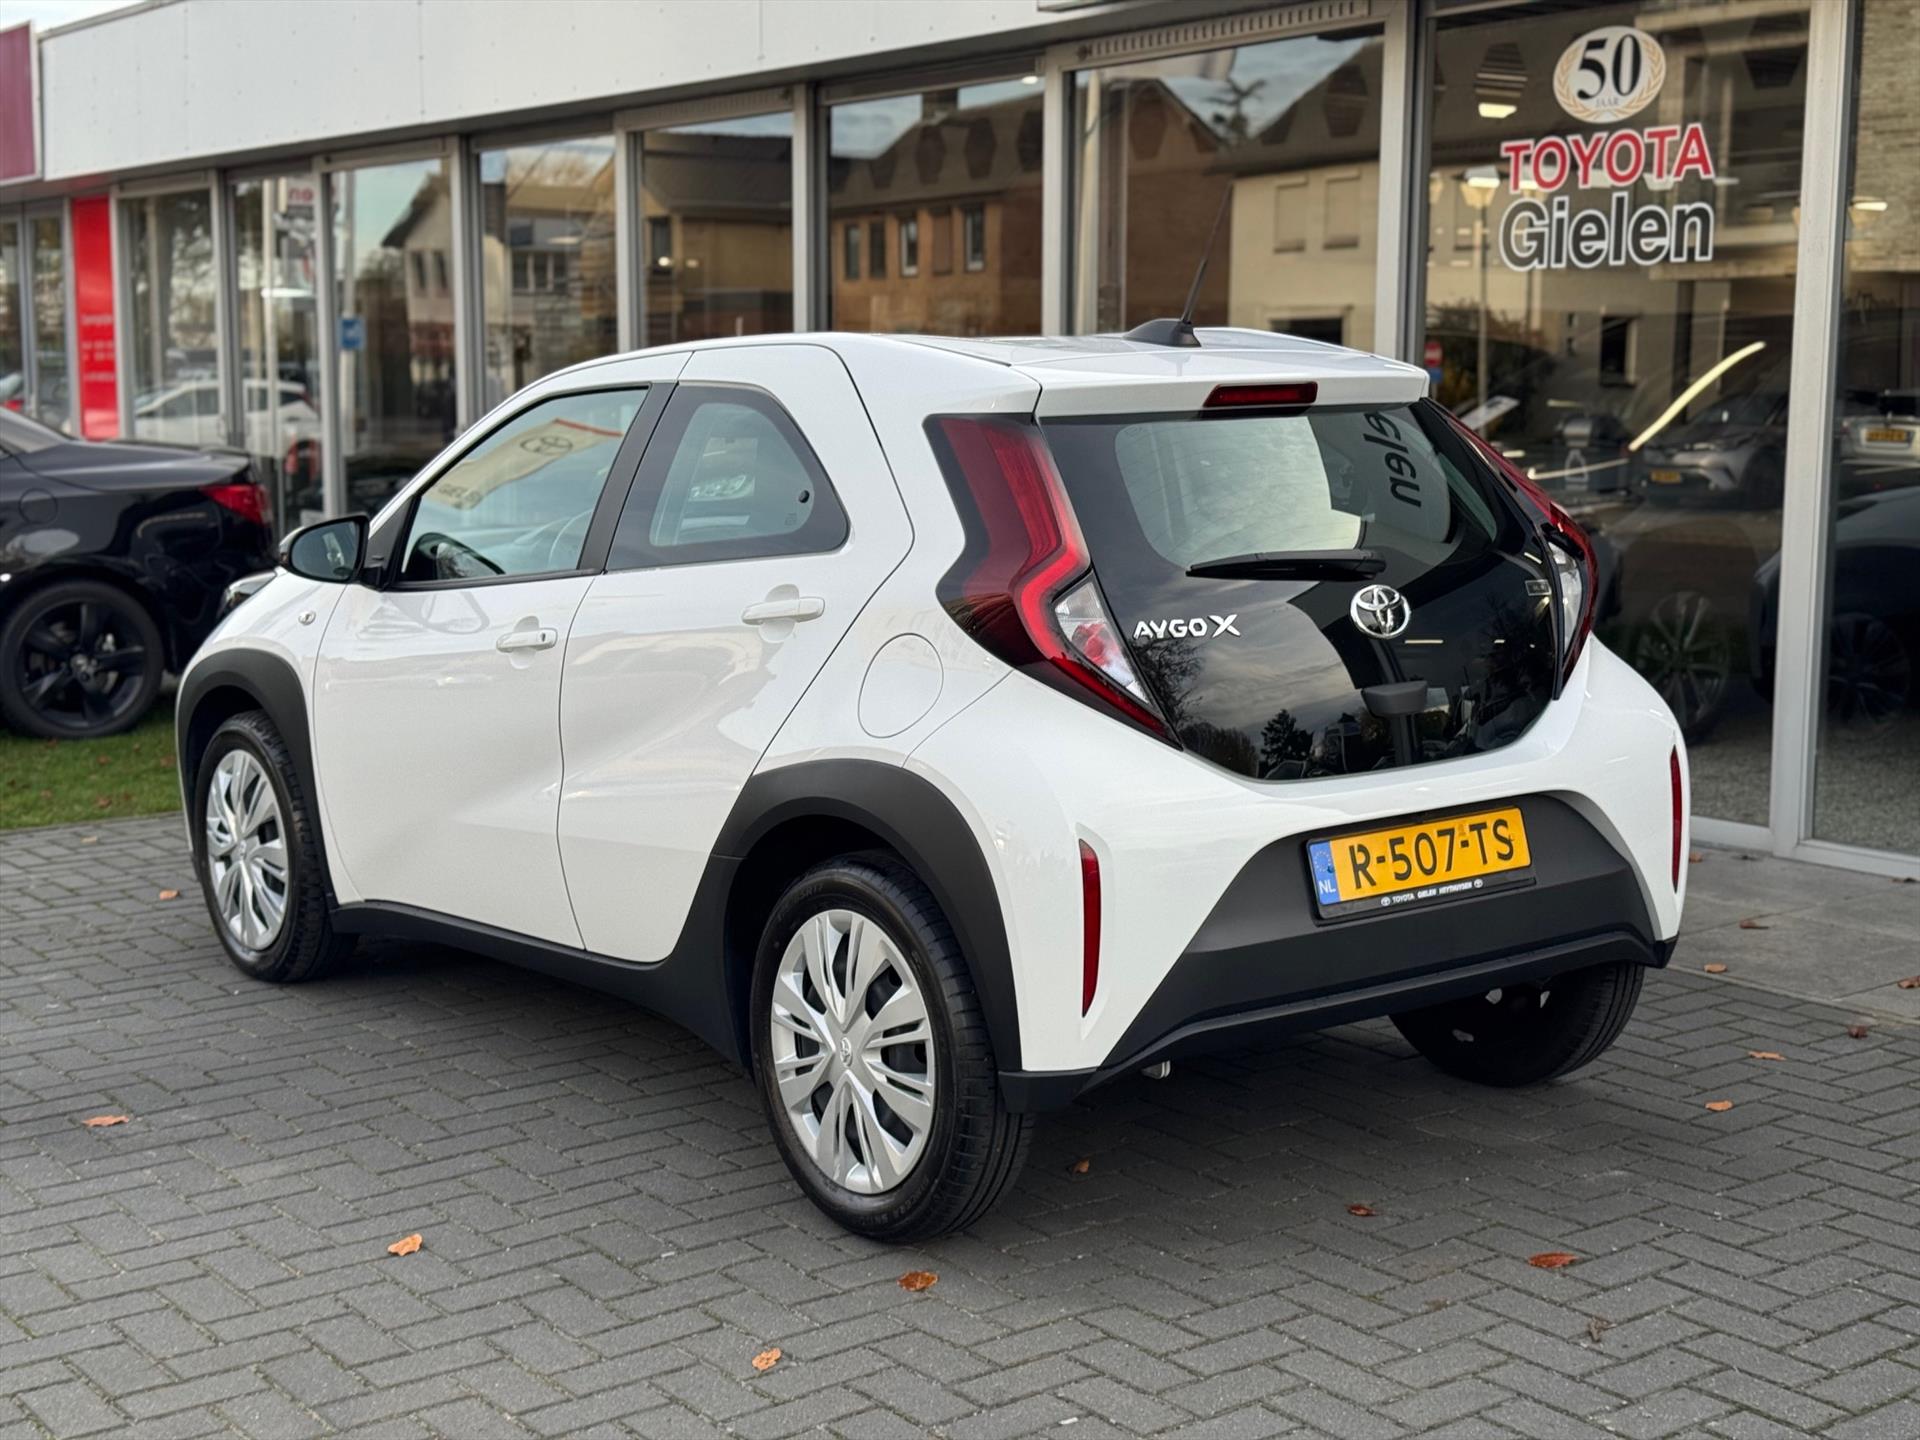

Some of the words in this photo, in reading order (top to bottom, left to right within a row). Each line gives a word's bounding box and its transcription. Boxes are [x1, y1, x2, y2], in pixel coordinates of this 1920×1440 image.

[1576, 34, 1642, 100] 50
[1501, 123, 1714, 194] TOYOTA
[1500, 191, 1714, 271] Gielen
[1133, 617, 1208, 640] AYGO
[1207, 613, 1242, 639] X
[1318, 879, 1337, 895] NL
[1348, 818, 1515, 890] R-507-TS
[1391, 892, 1415, 904] TOYOTA
